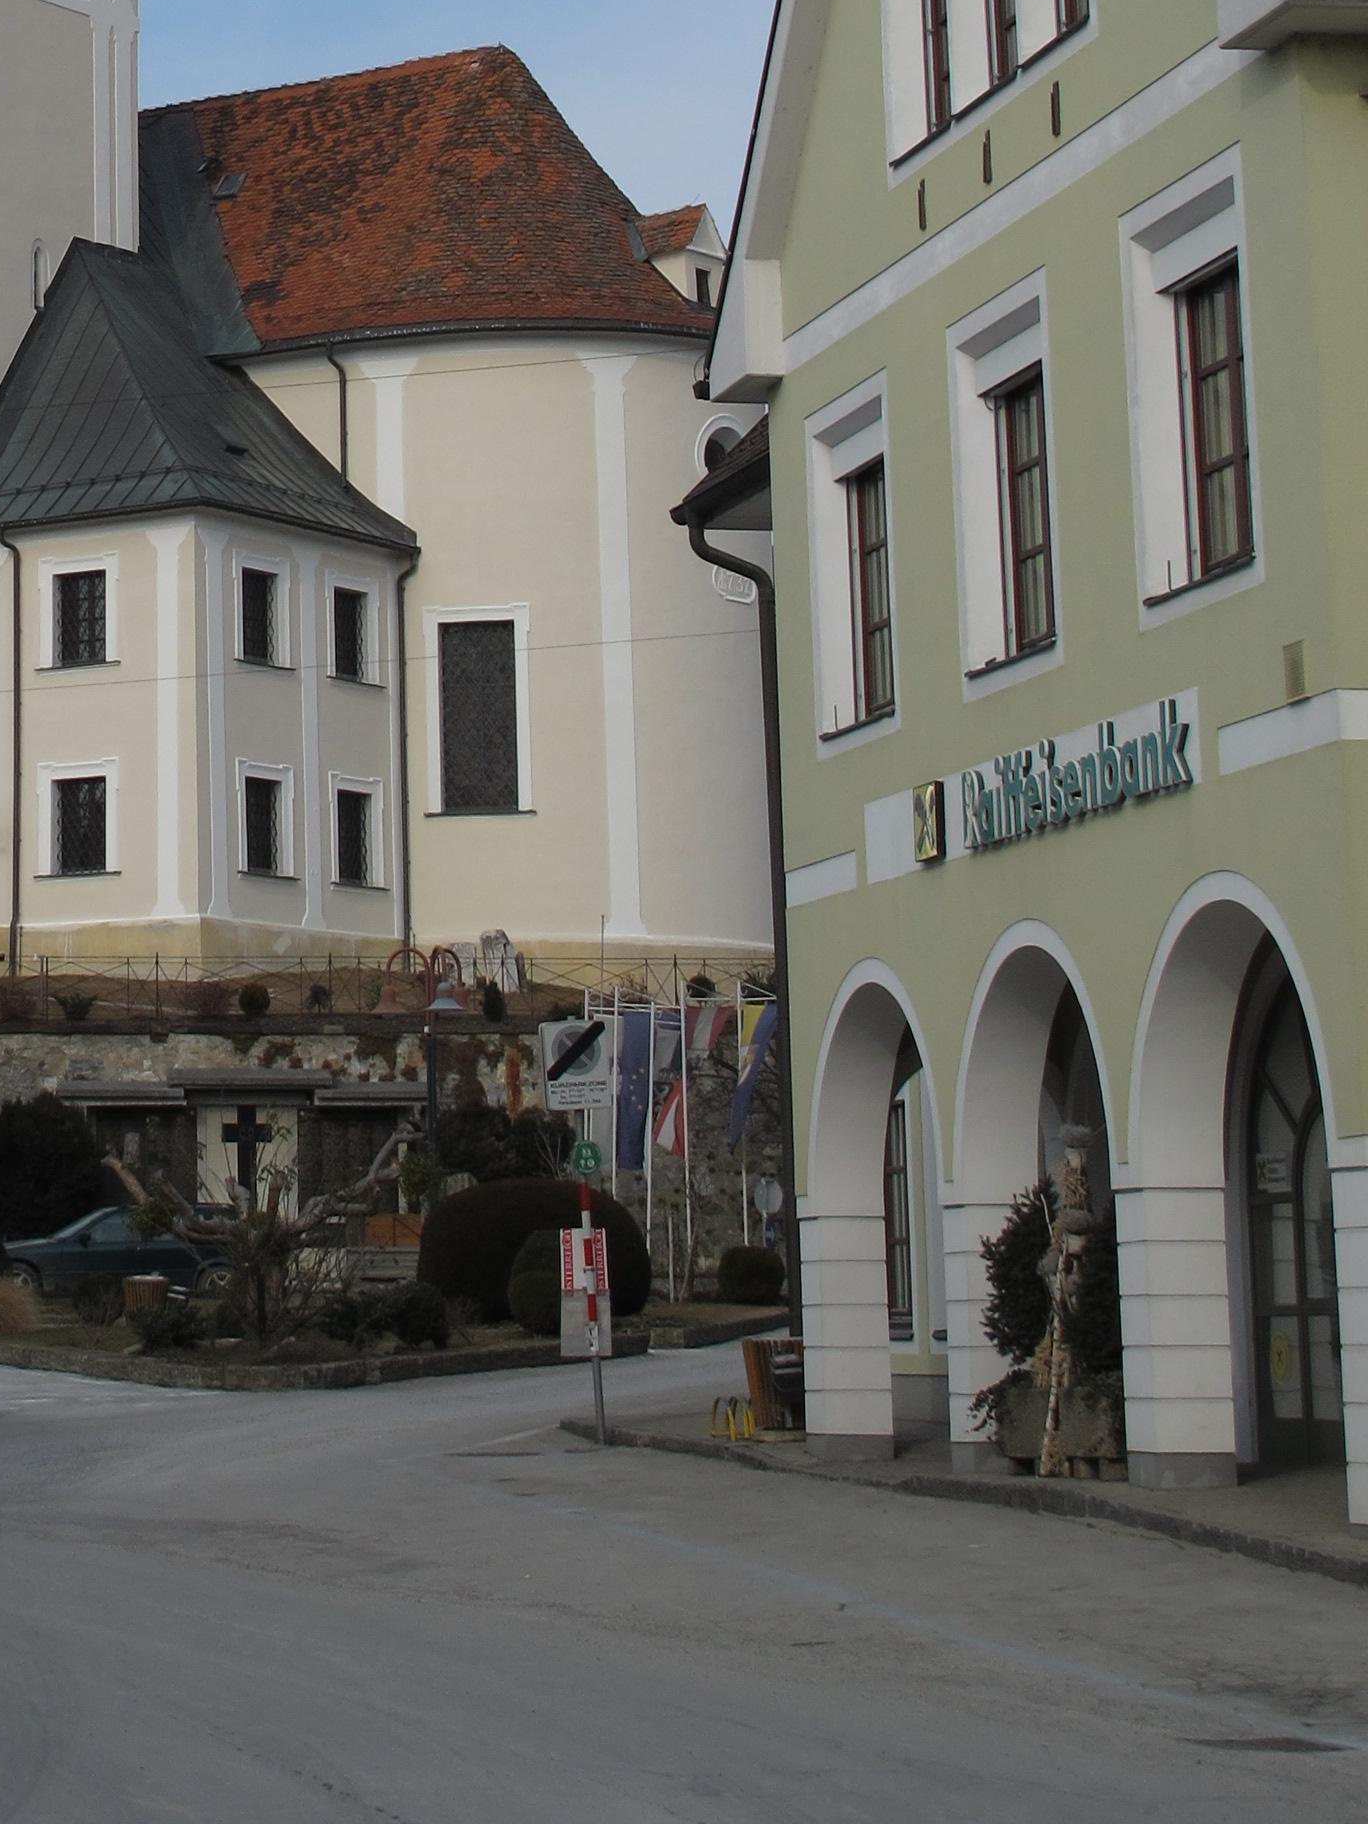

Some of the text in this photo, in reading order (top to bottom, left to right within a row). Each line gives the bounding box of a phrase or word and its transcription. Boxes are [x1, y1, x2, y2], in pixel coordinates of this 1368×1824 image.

[961, 697, 1194, 849] Raiffeisenbank
[563, 1228, 573, 1291] STERREICH
[594, 1228, 605, 1291] STERREICH
